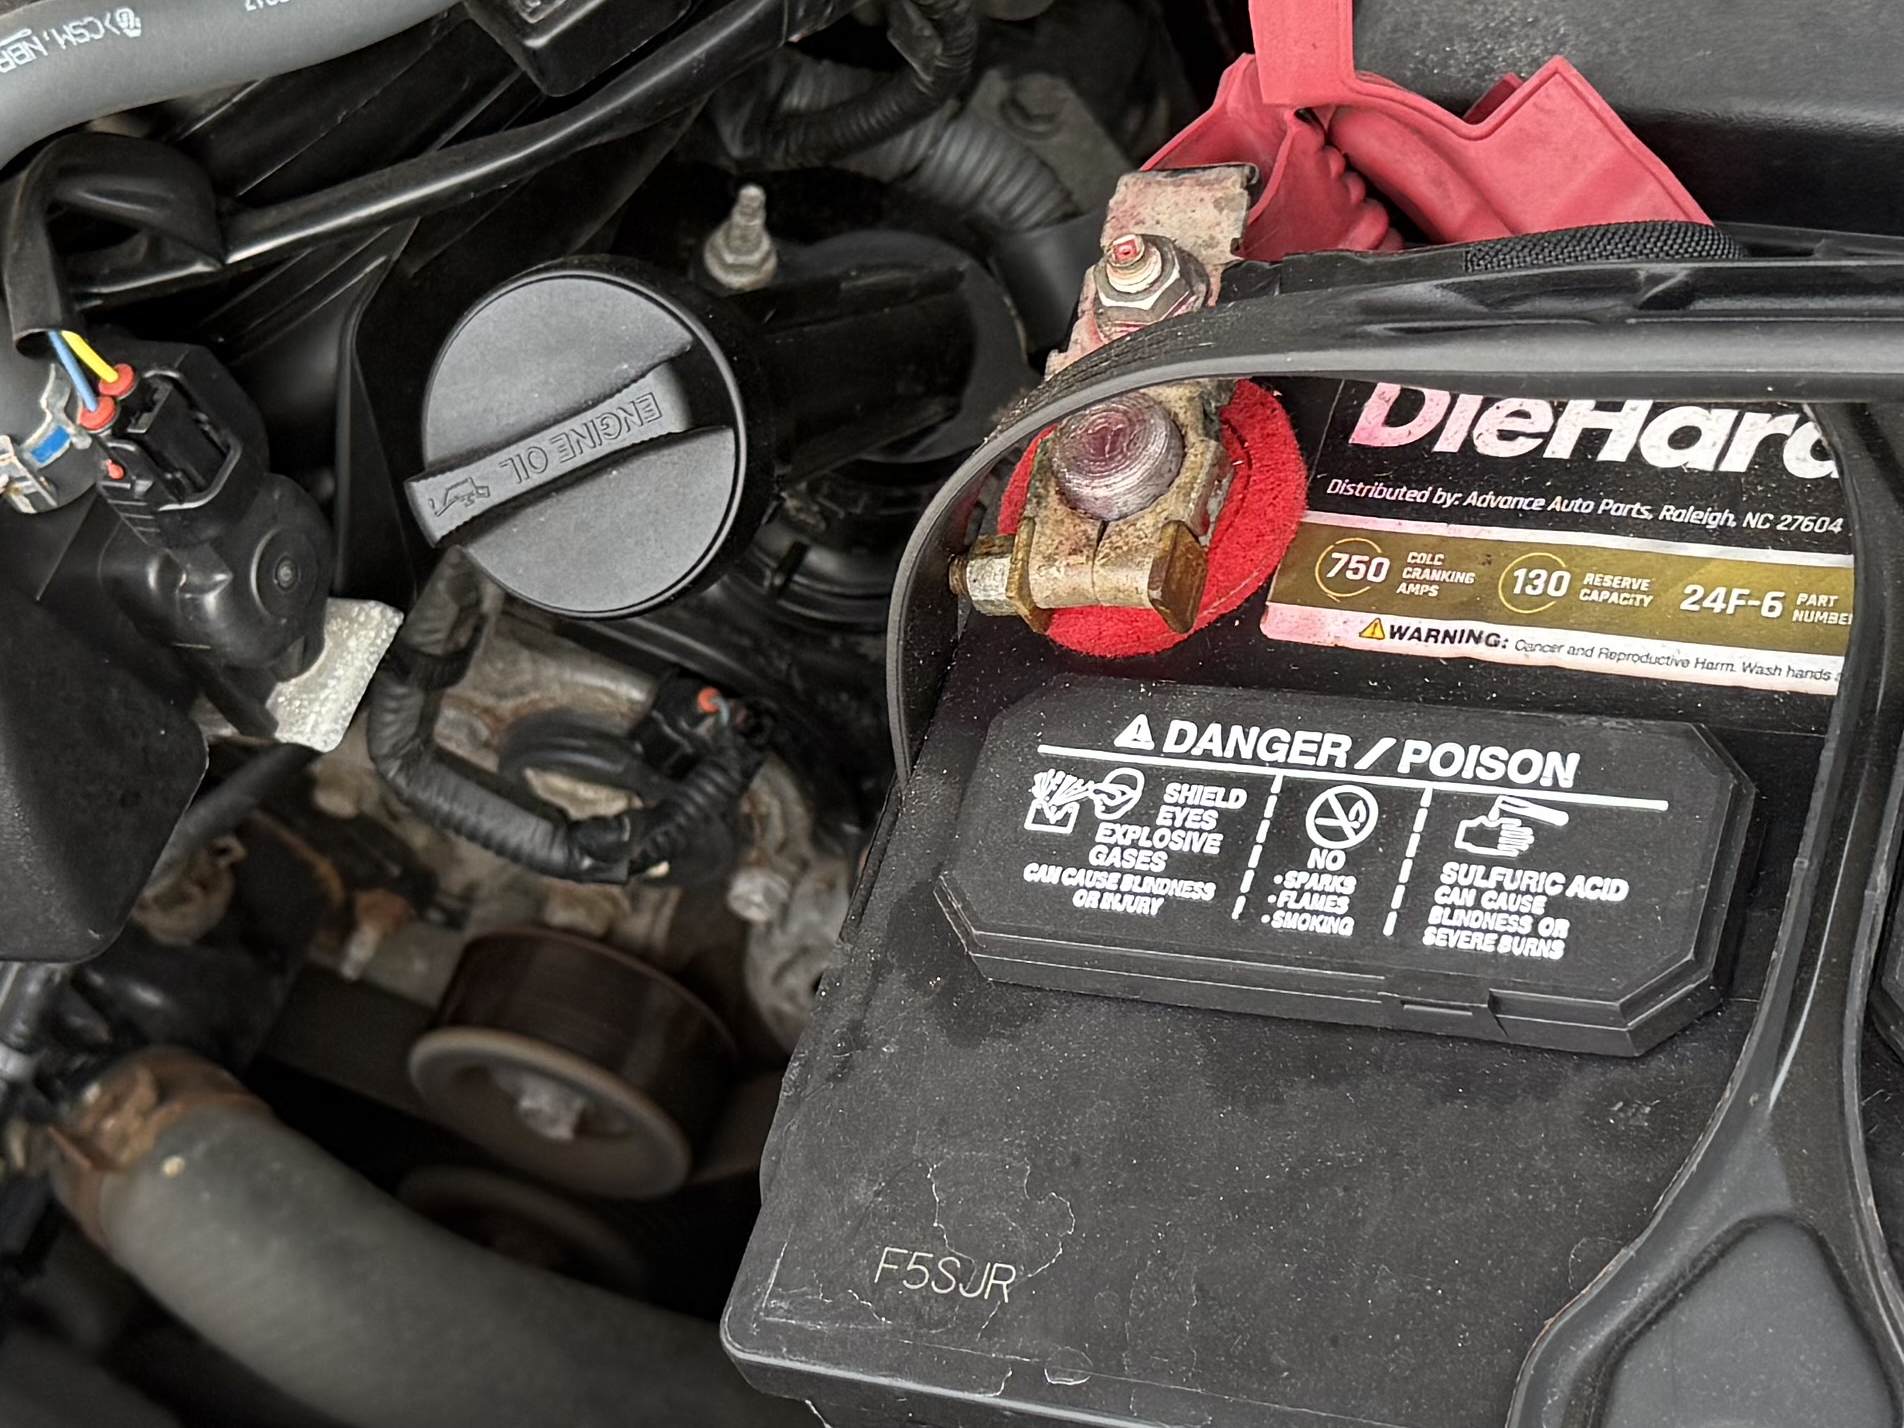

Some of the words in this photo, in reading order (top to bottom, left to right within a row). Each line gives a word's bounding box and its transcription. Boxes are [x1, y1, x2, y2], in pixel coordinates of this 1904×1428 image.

[551, 390, 663, 465] ENGINE
[498, 444, 550, 486] OIL
[1325, 478, 1433, 503] Distributed
[1461, 490, 1546, 511] Advance
[1546, 495, 1595, 513] Auto
[1741, 510, 1774, 529] NC
[1775, 513, 1844, 534] 27604
[1322, 549, 1390, 582] 750
[1401, 566, 1476, 584] CRANKING
[1508, 564, 1571, 597] 130
[1395, 581, 1439, 597] AMPS
[1582, 572, 1655, 591] RESERVE
[1578, 587, 1654, 607] CAPACITY
[1679, 583, 1785, 618] 24F-6
[1795, 592, 1838, 607] PART
[1388, 623, 1509, 649] WARNING:
[1161, 721, 1352, 768] DANGER
[1396, 740, 1580, 787] POISON
[1162, 781, 1247, 809] SHIELD
[1155, 806, 1219, 830] EYES
[1094, 822, 1223, 855] EXPLOSIVE
[1087, 847, 1168, 872] GASES
[1306, 847, 1346, 871] NO
[1022, 864, 1063, 885] CAN
[1060, 867, 1121, 891] CAUSE
[1118, 873, 1216, 900] BLINDNESS
[1439, 862, 1566, 896] SULFURIC
[1564, 874, 1629, 901] ACID
[1071, 890, 1101, 909] OR
[1098, 892, 1164, 915] INJURY
[1432, 886, 1477, 907] CAN
[1480, 890, 1547, 914] CAUSE
[1427, 907, 1533, 934] BLINDNESS
[1536, 916, 1570, 937] OR
[1421, 928, 1498, 952] SEVERE
[1496, 934, 1565, 959] BURNS
[873, 1246, 1017, 1304] F5SJR
